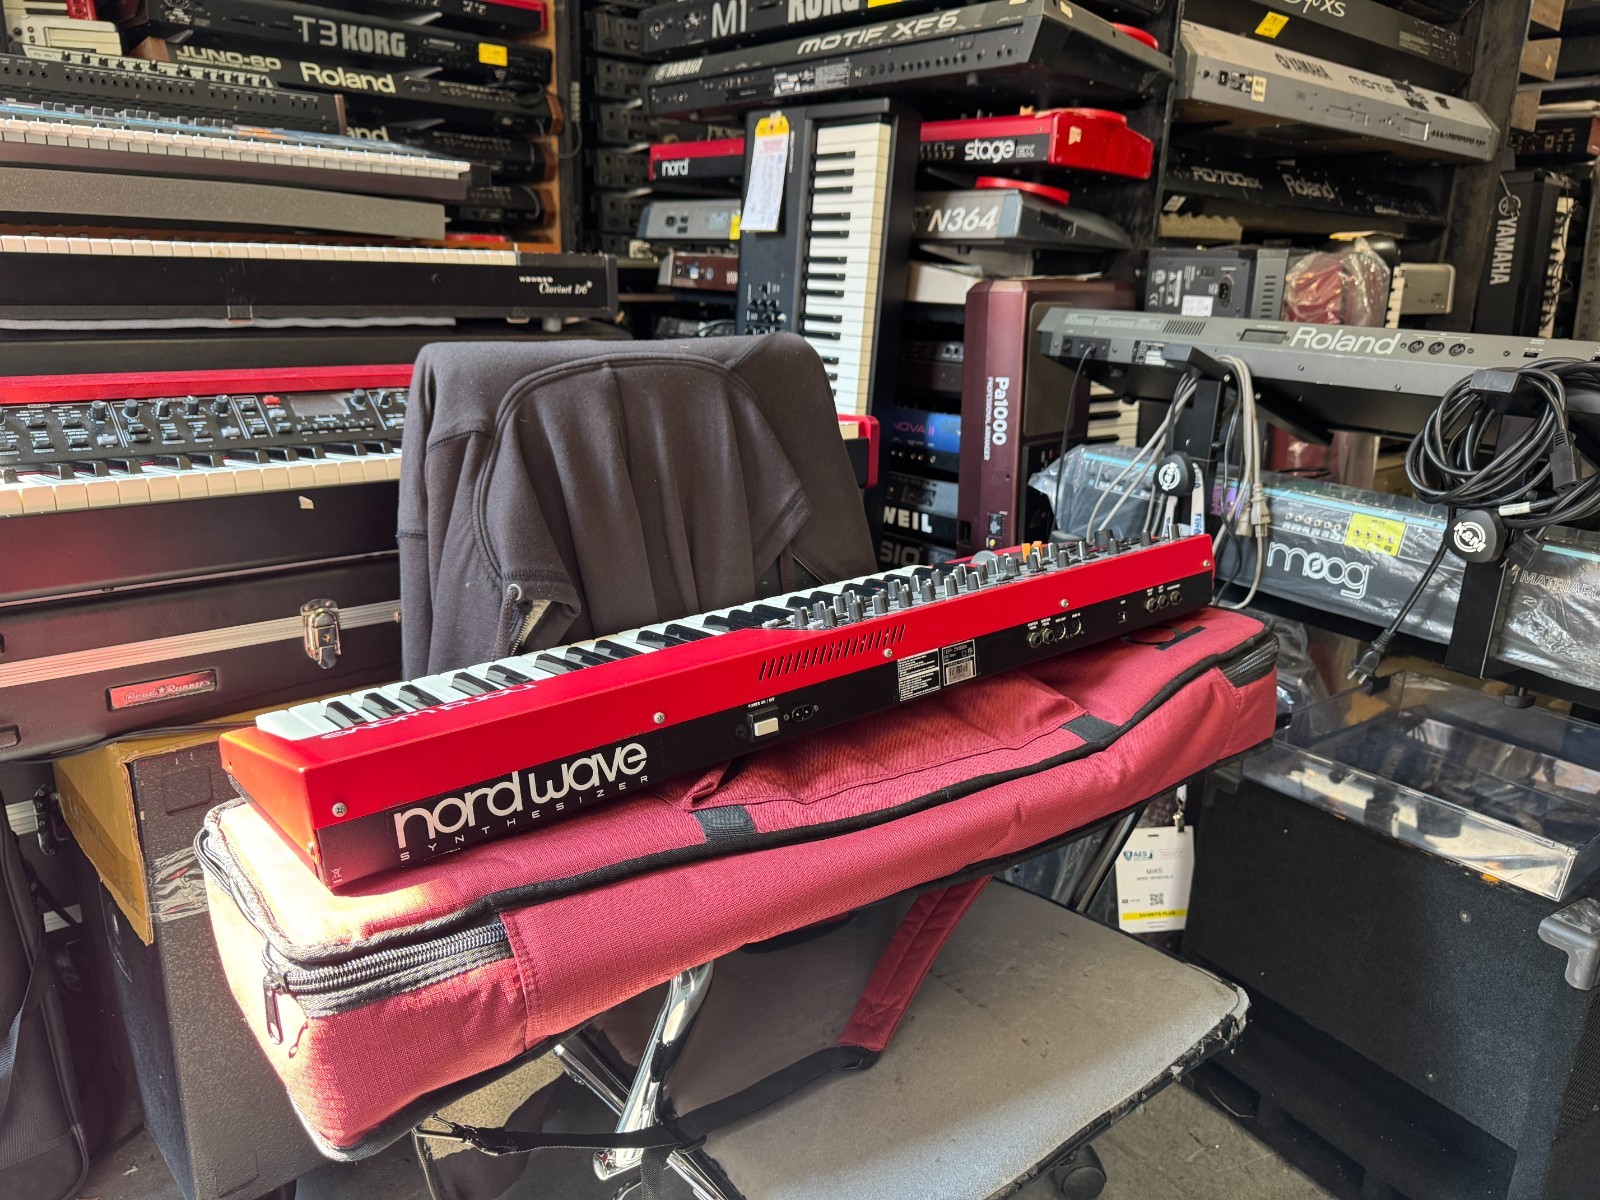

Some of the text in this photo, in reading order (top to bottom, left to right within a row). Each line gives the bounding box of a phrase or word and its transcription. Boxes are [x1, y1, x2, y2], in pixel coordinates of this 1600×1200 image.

[711, 0, 747, 38] M1
[797, 9, 962, 54] MOTIF XF6
[293, 15, 406, 58] T3 KORG
[176, 45, 282, 70] JUNO-60
[299, 61, 397, 95] Roland
[346, 125, 389, 142] and
[964, 138, 1036, 163] stage EX
[661, 158, 690, 177] nord
[1282, 174, 1336, 201] Roland
[928, 205, 1000, 232] N364
[1489, 216, 1518, 285] YAMAHA
[1290, 326, 1400, 356] Roland
[992, 376, 1010, 446] Pa1000
[1453, 521, 1487, 553] K&M
[1266, 541, 1370, 599] moog
[394, 742, 648, 849] nord wave
[400, 775, 649, 861] SYNTHESIZER
